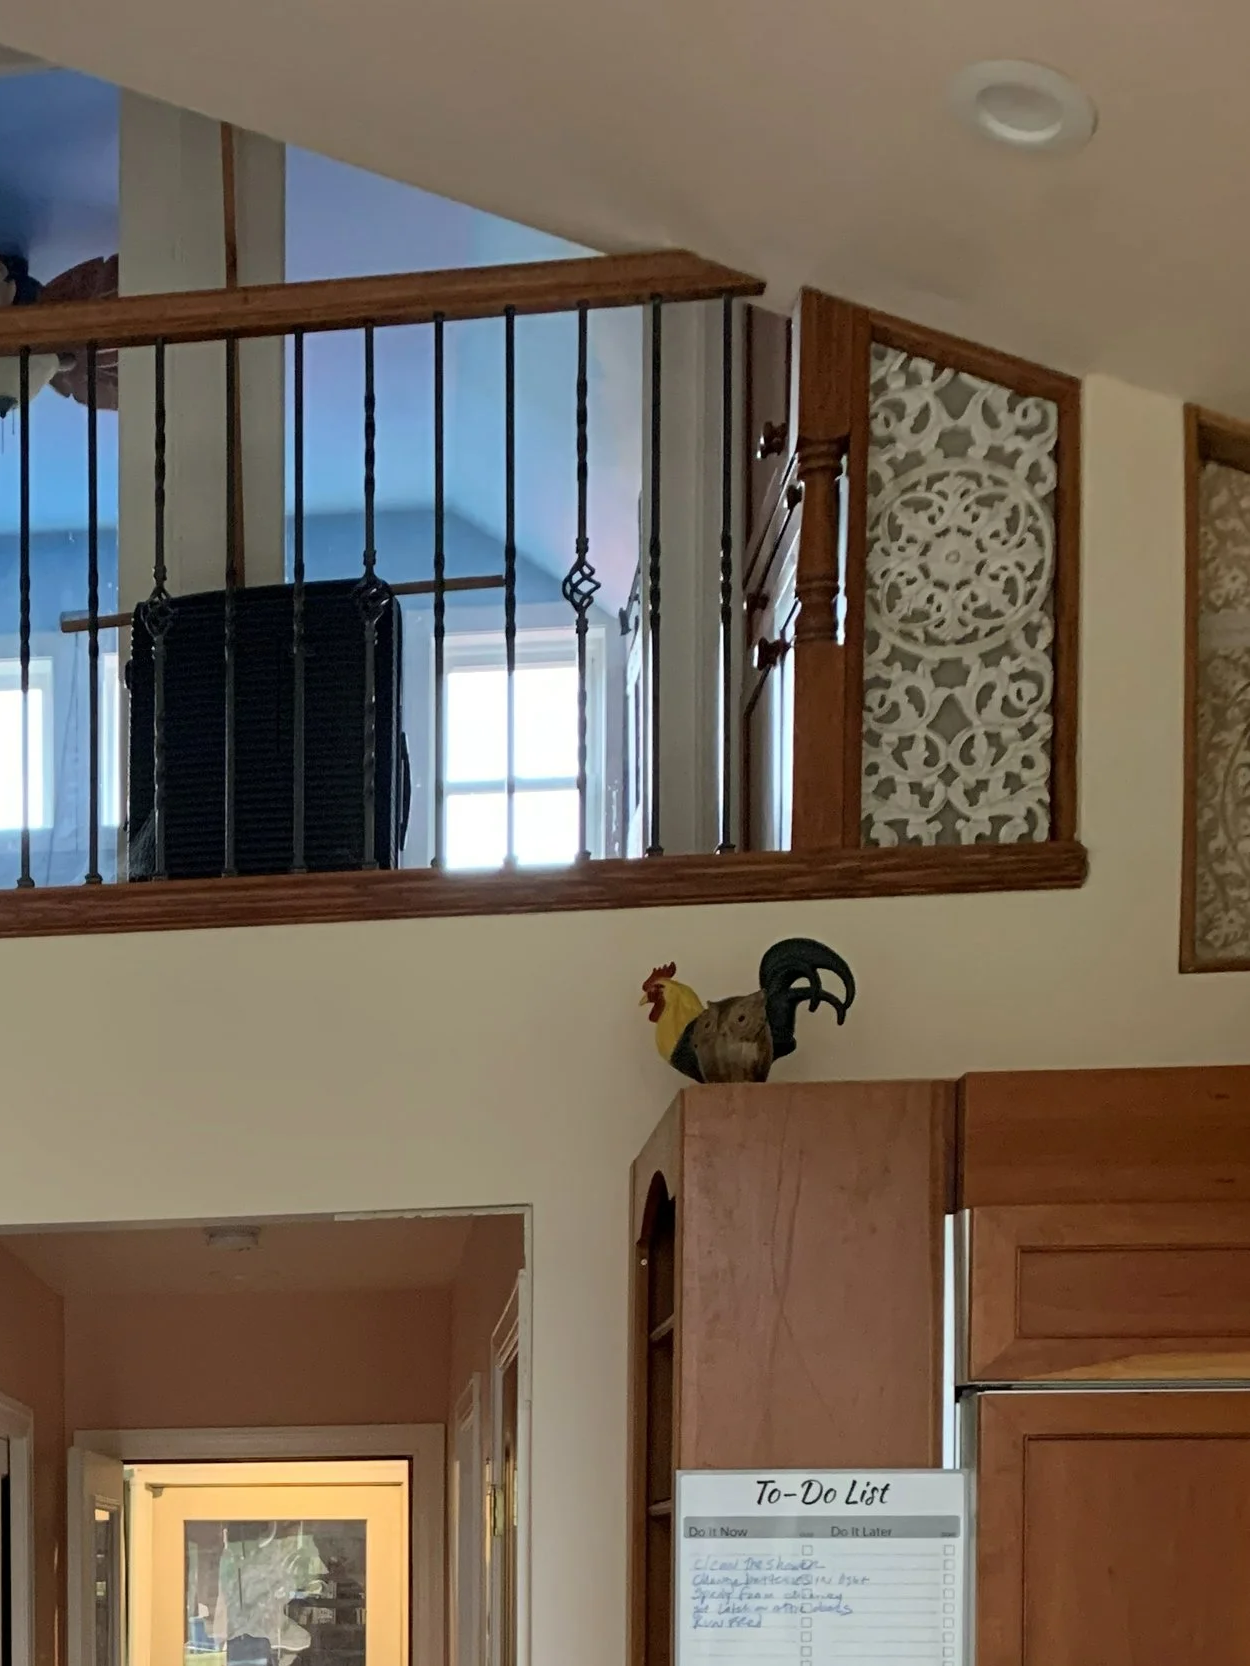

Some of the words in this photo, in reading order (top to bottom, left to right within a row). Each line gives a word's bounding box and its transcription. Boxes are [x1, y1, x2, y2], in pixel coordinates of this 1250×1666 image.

[756, 1479, 837, 1506] To-Do
[845, 1479, 891, 1506] List
[689, 1526, 705, 1537] Do
[720, 1526, 748, 1537] Now
[831, 1526, 848, 1537] Do
[863, 1526, 892, 1537] Later
